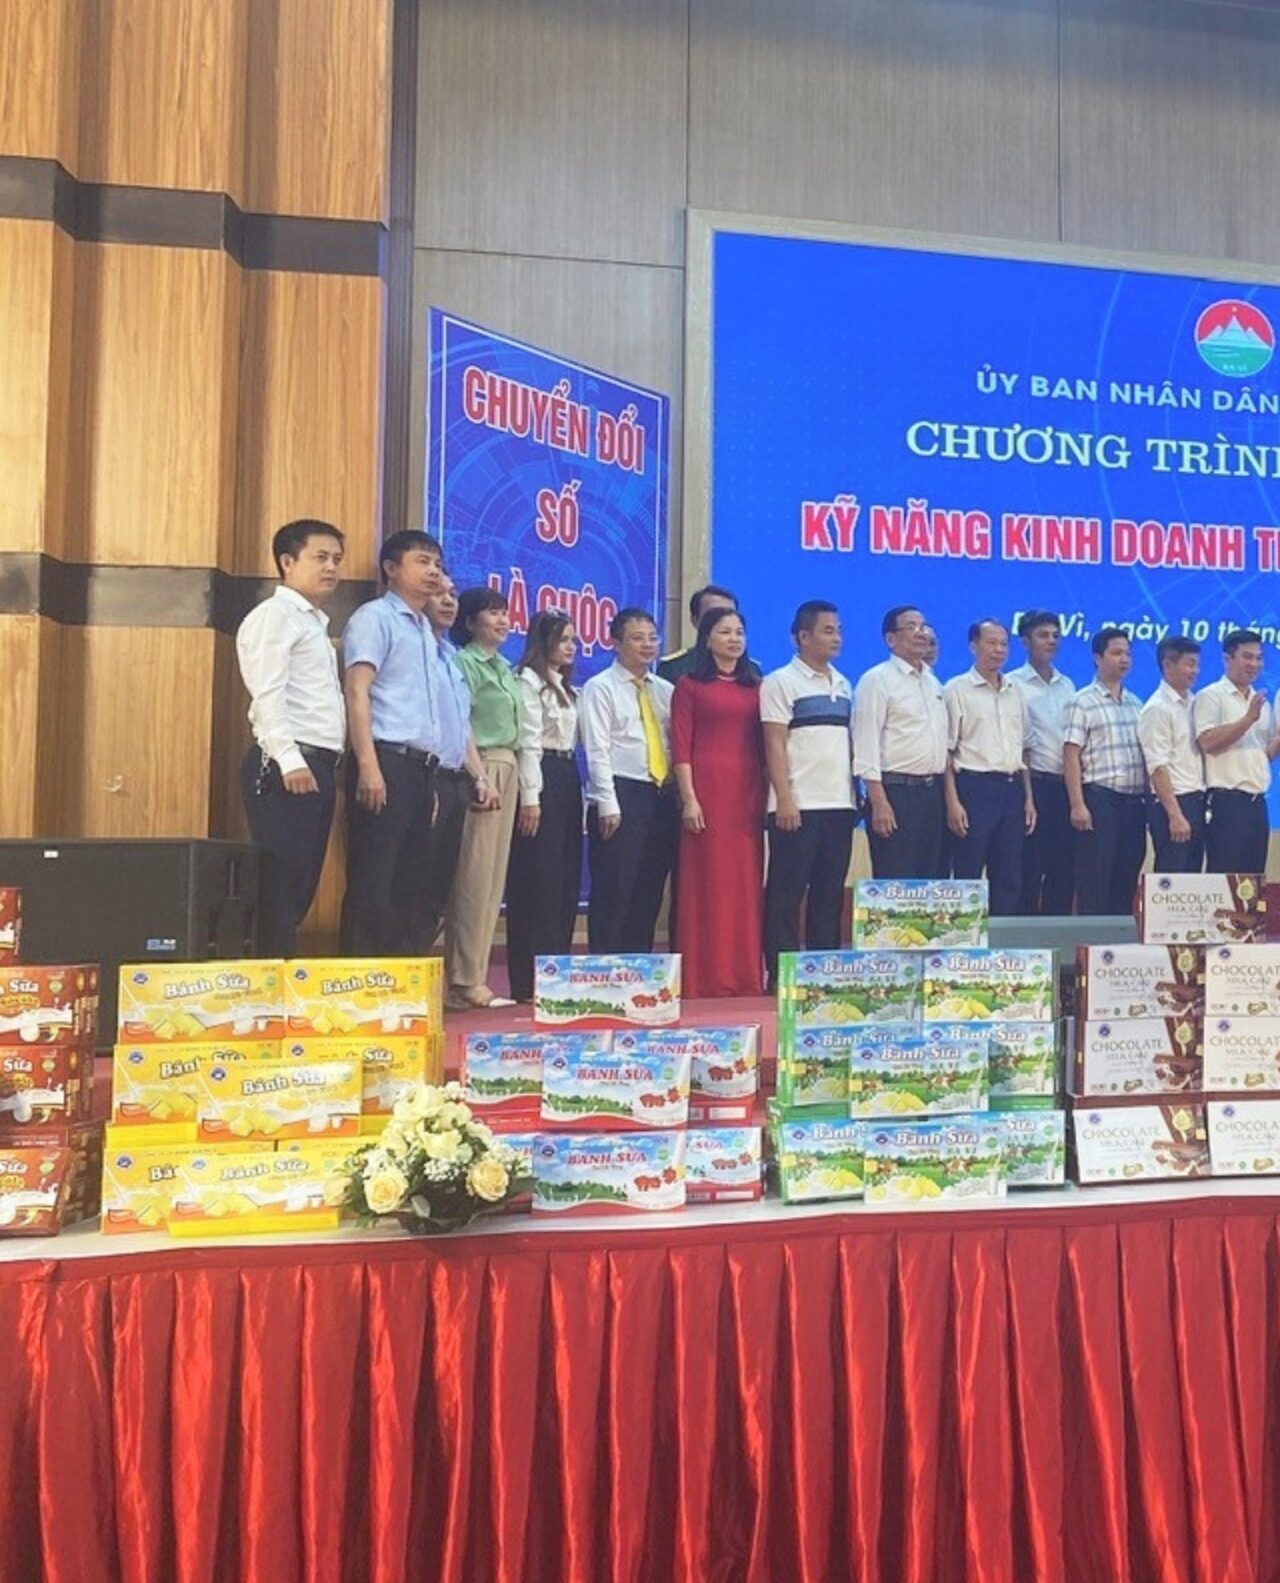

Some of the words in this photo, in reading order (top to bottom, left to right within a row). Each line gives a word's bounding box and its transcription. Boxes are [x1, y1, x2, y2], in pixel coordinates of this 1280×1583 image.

[976, 364, 1020, 396] ỦY
[1031, 376, 1097, 401] BAN
[1110, 378, 1201, 410] NHÂN
[1213, 387, 1280, 415] DÂN
[463, 366, 590, 457] CHUYỂN
[597, 404, 645, 475] ĐỔI
[907, 421, 1131, 468] CHƯƠNG
[536, 480, 581, 547] SỐ
[801, 494, 860, 551] KỸ
[871, 500, 991, 559] NĂNG
[1002, 514, 1100, 563] KINH
[1112, 521, 1244, 570] DOANH
[1181, 620, 1209, 641] 10
[1151, 893, 1225, 904] CHOCOLATE
